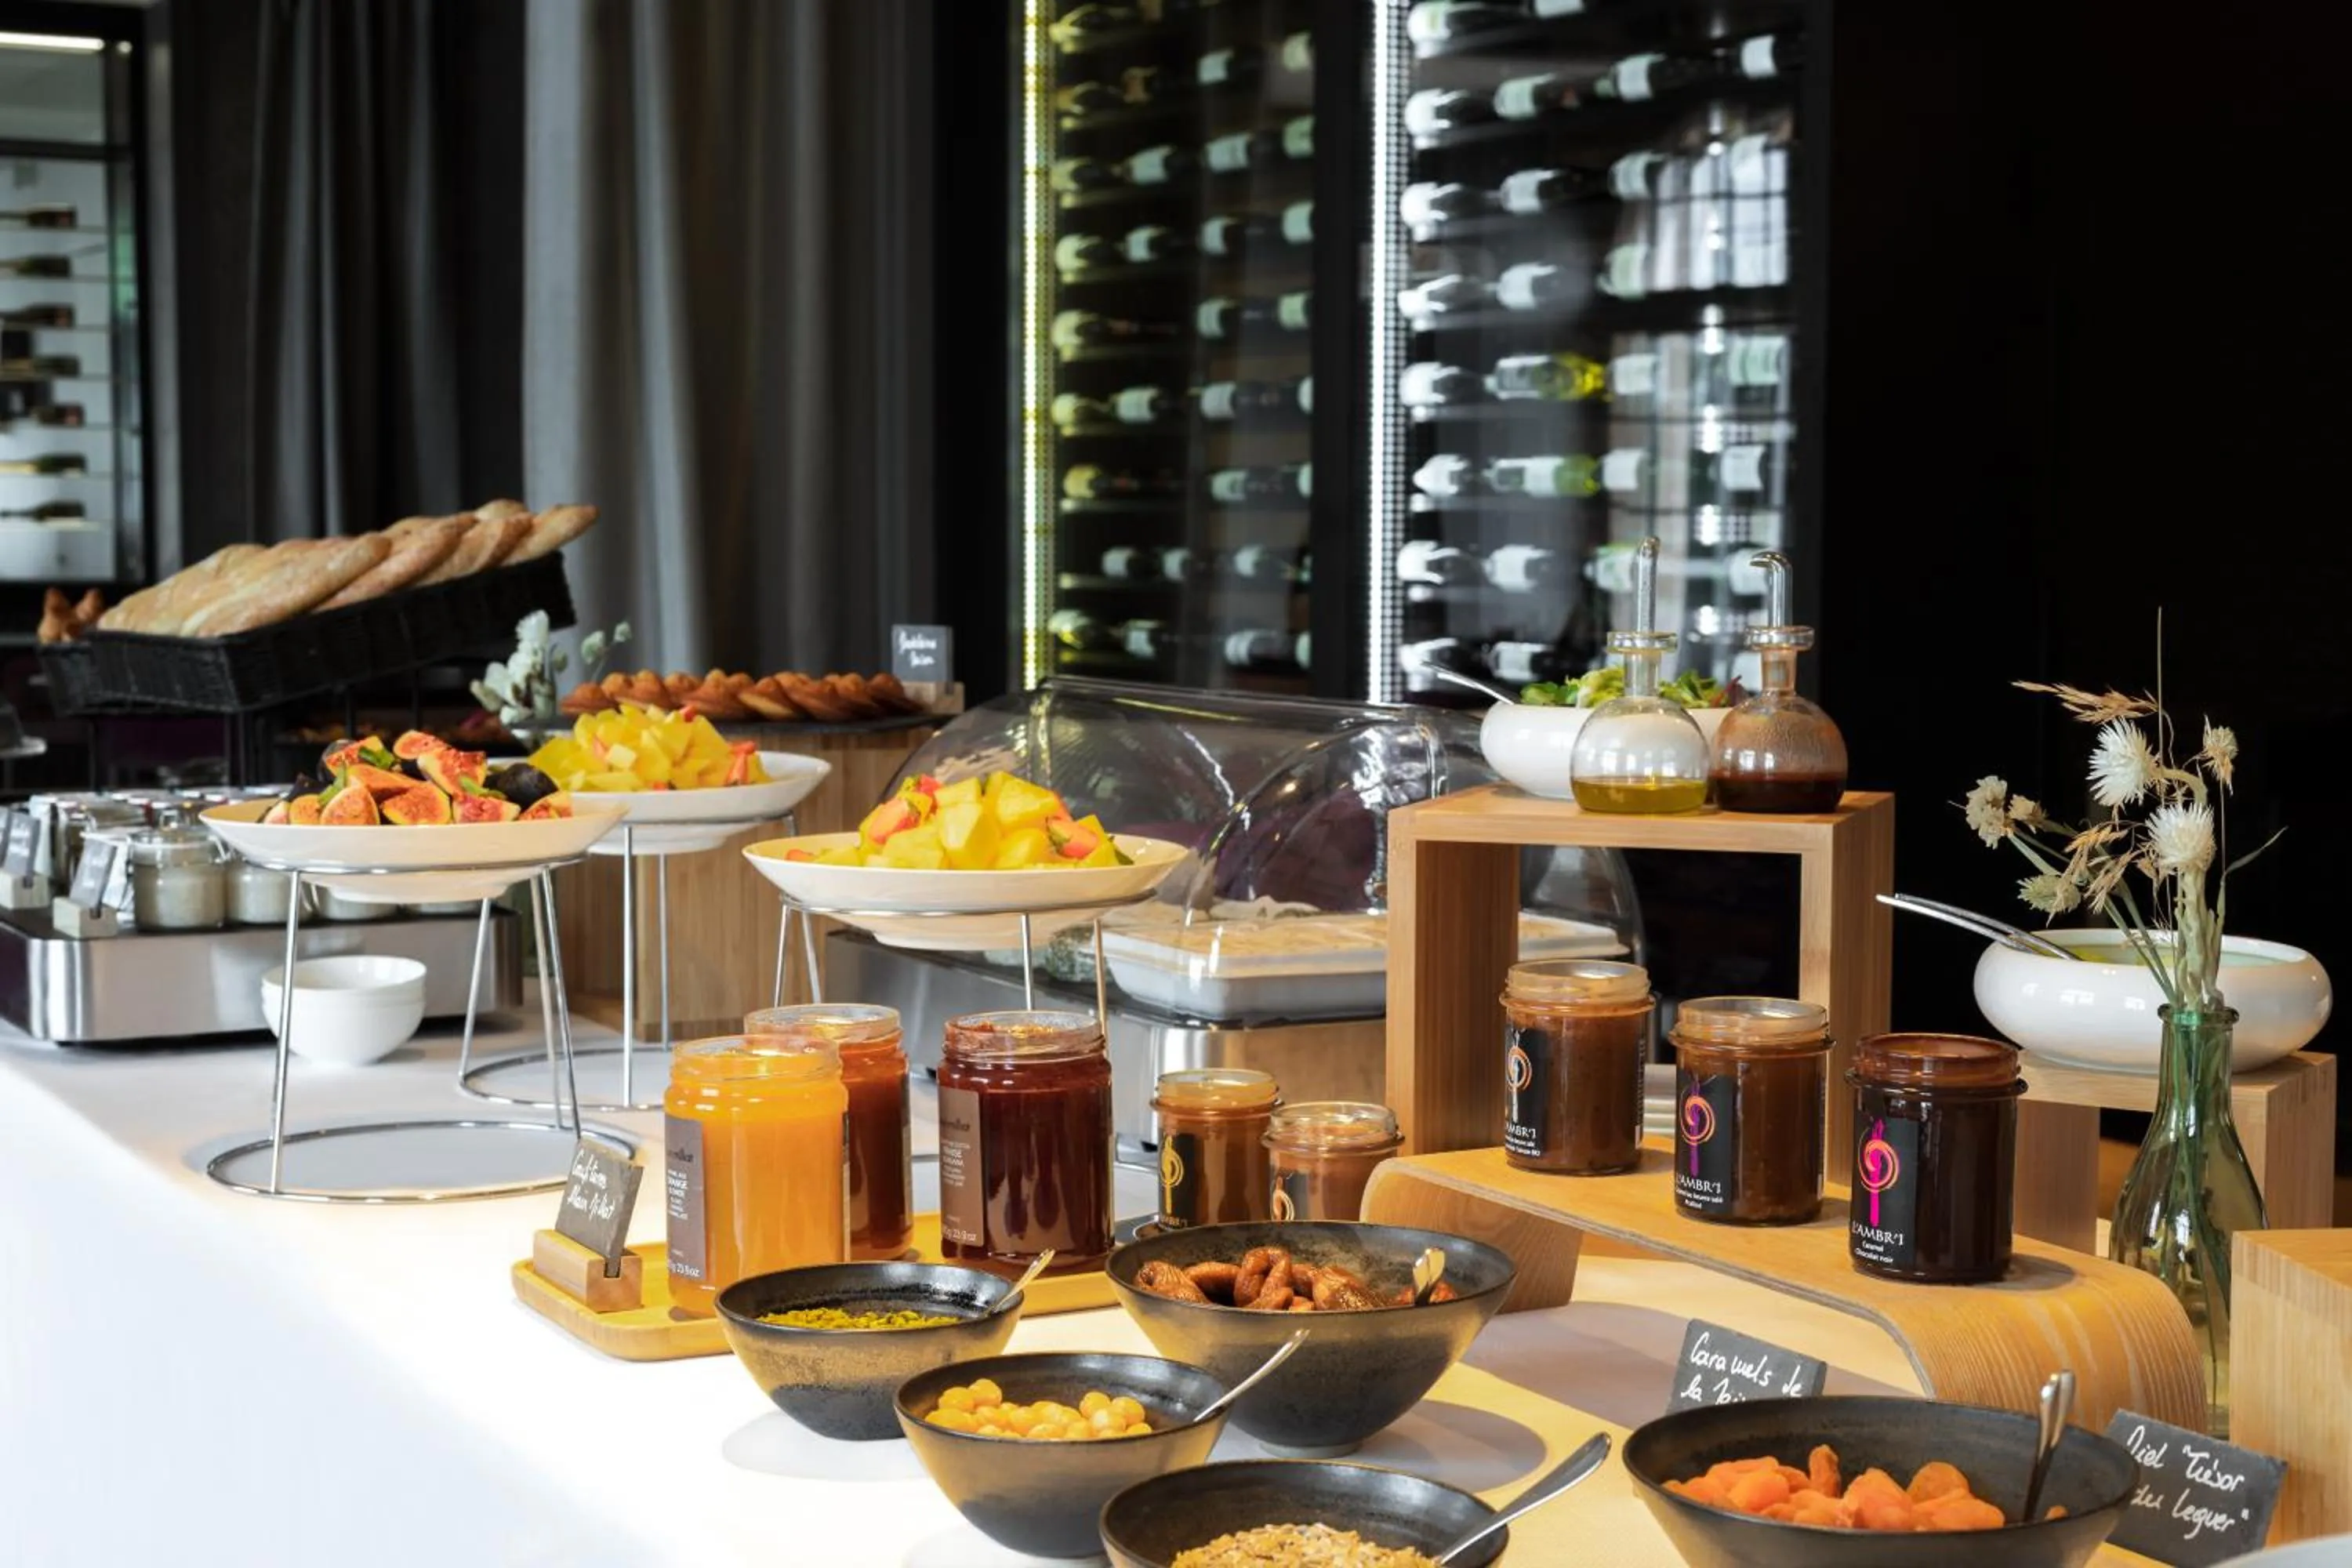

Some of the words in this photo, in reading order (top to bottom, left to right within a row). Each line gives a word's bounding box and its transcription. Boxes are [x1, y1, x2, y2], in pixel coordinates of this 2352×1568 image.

[1690, 1331, 1773, 1387] Caramels
[1781, 1364, 1802, 1397] de
[1680, 1374, 1702, 1403] la
